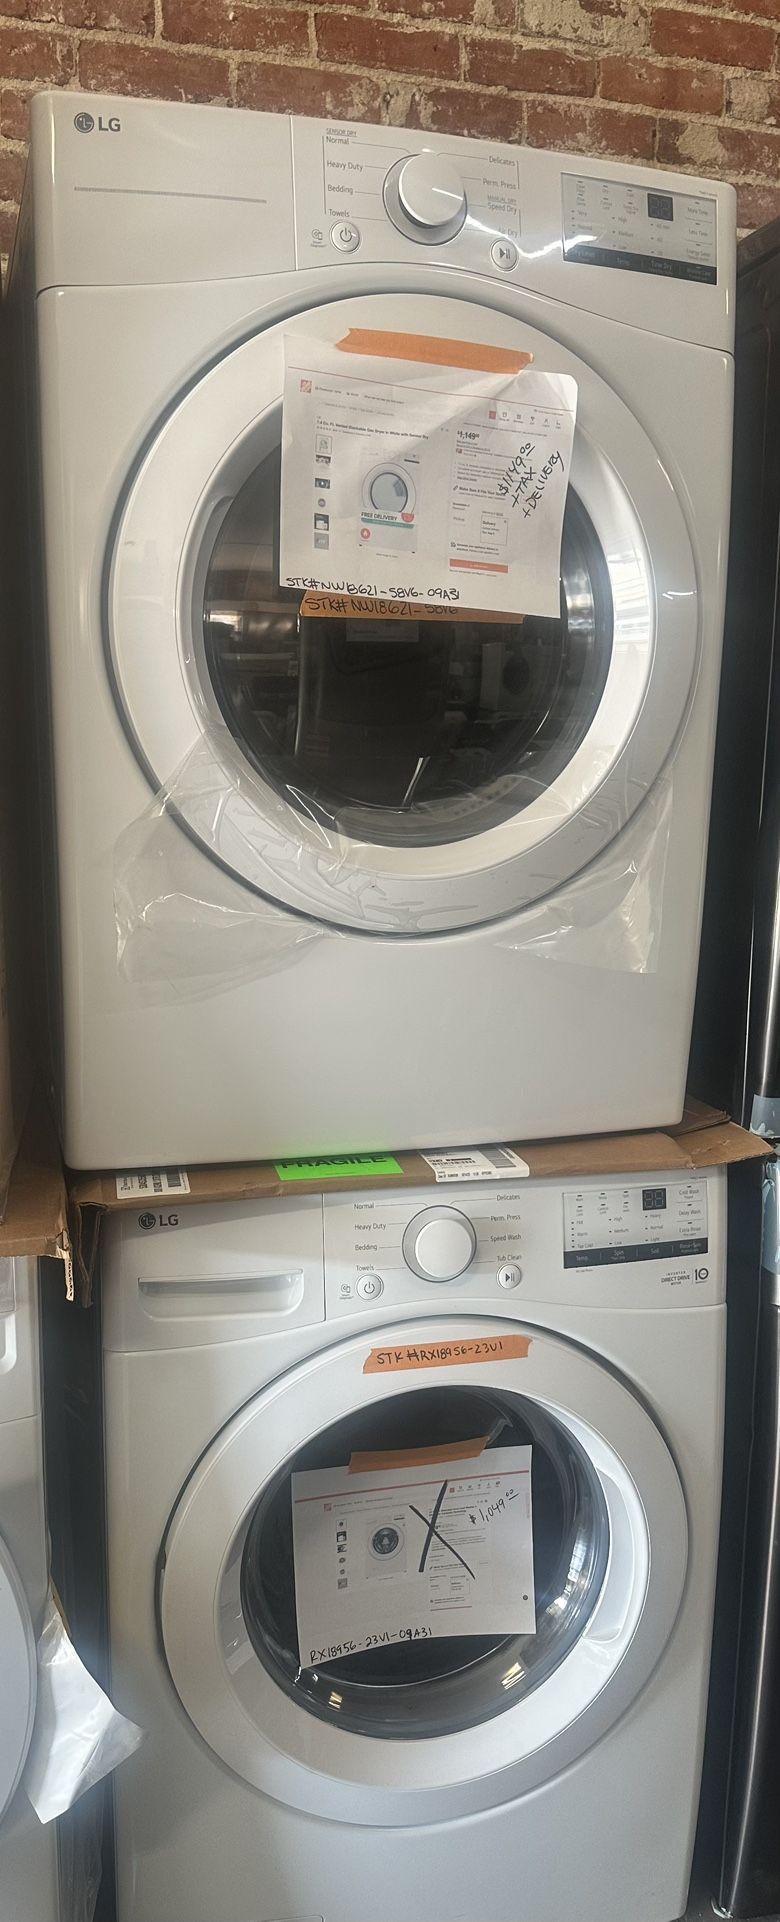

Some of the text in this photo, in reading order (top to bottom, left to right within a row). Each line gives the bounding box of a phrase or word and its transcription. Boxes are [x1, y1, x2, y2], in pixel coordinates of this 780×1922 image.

[98, 116, 121, 133] LG
[326, 136, 350, 145] Normal
[327, 160, 363, 172] Heavy Duty
[489, 155, 516, 167] Delicates
[328, 184, 354, 196] Bedding
[500, 180, 517, 190] Press
[329, 208, 350, 218] Towels
[488, 202, 517, 215] Speed Dry
[508, 228, 518, 239] Dry
[496, 1193, 521, 1201] Delicates
[354, 1202, 375, 1210] Normal
[159, 1214, 179, 1227] LG
[506, 1213, 521, 1221] Press
[354, 1221, 387, 1231] Heavy Duty
[490, 1233, 522, 1243] Speed Wash
[354, 1243, 378, 1251] Bedding
[497, 1253, 523, 1262] Tub Clean
[694, 1267, 709, 1281] 10
